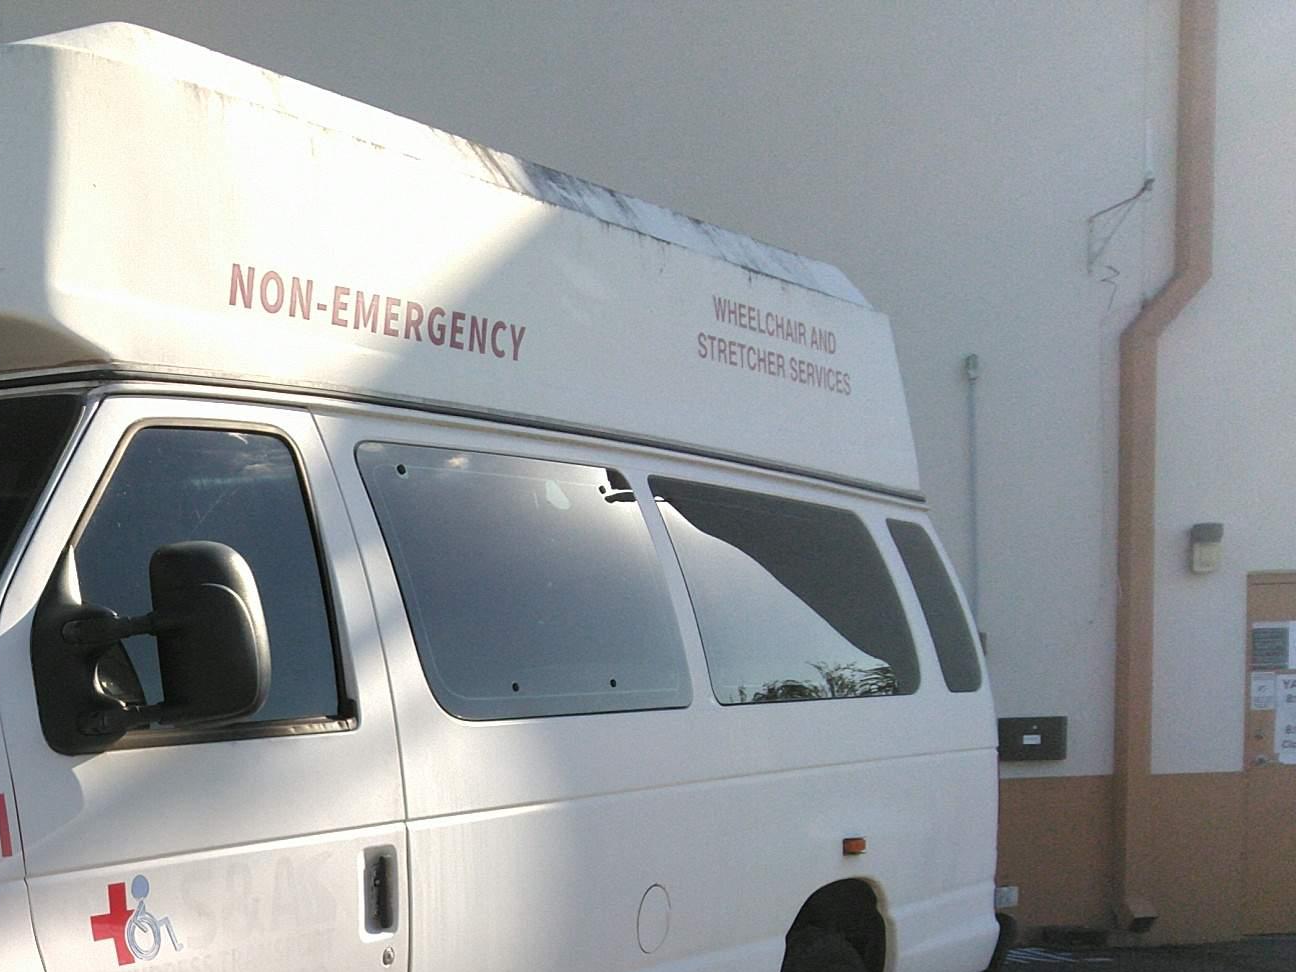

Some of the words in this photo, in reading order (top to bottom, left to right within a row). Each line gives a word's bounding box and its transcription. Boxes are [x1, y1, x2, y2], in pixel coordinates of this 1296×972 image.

[228, 263, 526, 362] NON-EMERGENCY
[712, 295, 806, 345] WHEELCHAIR
[810, 327, 836, 354] AND
[697, 332, 786, 378] STRETCHER
[789, 356, 852, 396] SERVICES
